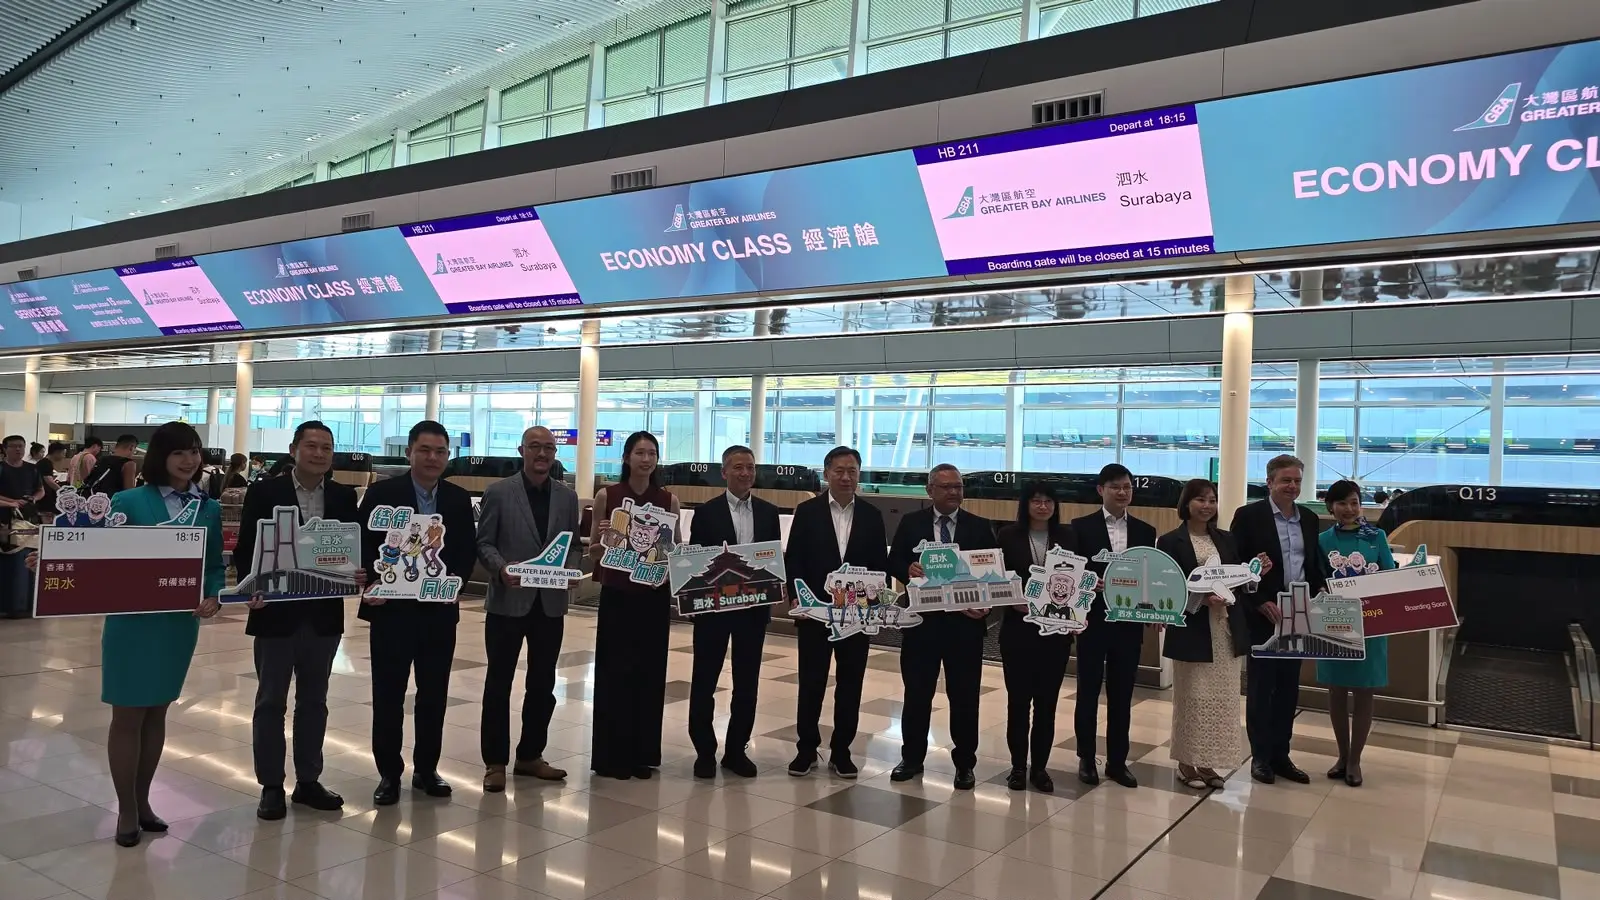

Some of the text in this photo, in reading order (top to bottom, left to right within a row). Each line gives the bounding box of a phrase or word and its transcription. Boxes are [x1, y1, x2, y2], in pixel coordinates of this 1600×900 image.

[1484, 97, 1514, 124] GBA
[1110, 113, 1186, 134] Depart at 18:15
[938, 143, 980, 159] HB 211
[1116, 170, 1148, 187] 泗水
[1293, 144, 1532, 198] ECONOMY
[978, 188, 1036, 204] 大灣區航空
[980, 192, 1106, 215] GREATER BAY AIRLINES
[1120, 188, 1192, 208] Surabaya
[958, 195, 973, 216] GBA
[690, 211, 776, 229] GREATER BAY AIRLINES
[412, 224, 435, 234] HB 211
[802, 222, 880, 252] 經濟艙
[600, 232, 792, 271] ECONOMY CLASS
[988, 242, 1210, 271] Boarding gate will be closed at 15 minutes
[450, 265, 474, 273] GREATER
[488, 261, 514, 269] AIRLINES
[520, 262, 557, 272] Surabaya
[243, 280, 355, 305] ECONOMY CLASS
[690, 463, 708, 472] Q09
[777, 466, 795, 476] Q10
[994, 473, 1016, 484] Q11
[1135, 477, 1149, 488] 12
[1459, 487, 1497, 500] Q13
[178, 508, 195, 524] GBA
[371, 507, 412, 529] 結伴
[67, 532, 85, 541] 211
[176, 532, 200, 542] 18:15
[545, 543, 565, 563] GBA
[929, 553, 947, 563] 泗水
[46, 563, 75, 572] 香港至
[1417, 568, 1436, 576] 18:15
[44, 577, 75, 590] 泗水
[158, 578, 196, 587] 預備登機
[420, 578, 459, 599] 同行
[693, 592, 766, 610] 泗水 Surabaya
[800, 587, 815, 606] GBA
[1405, 603, 1431, 611] Boarding
[1135, 612, 1175, 621] Surabaya
